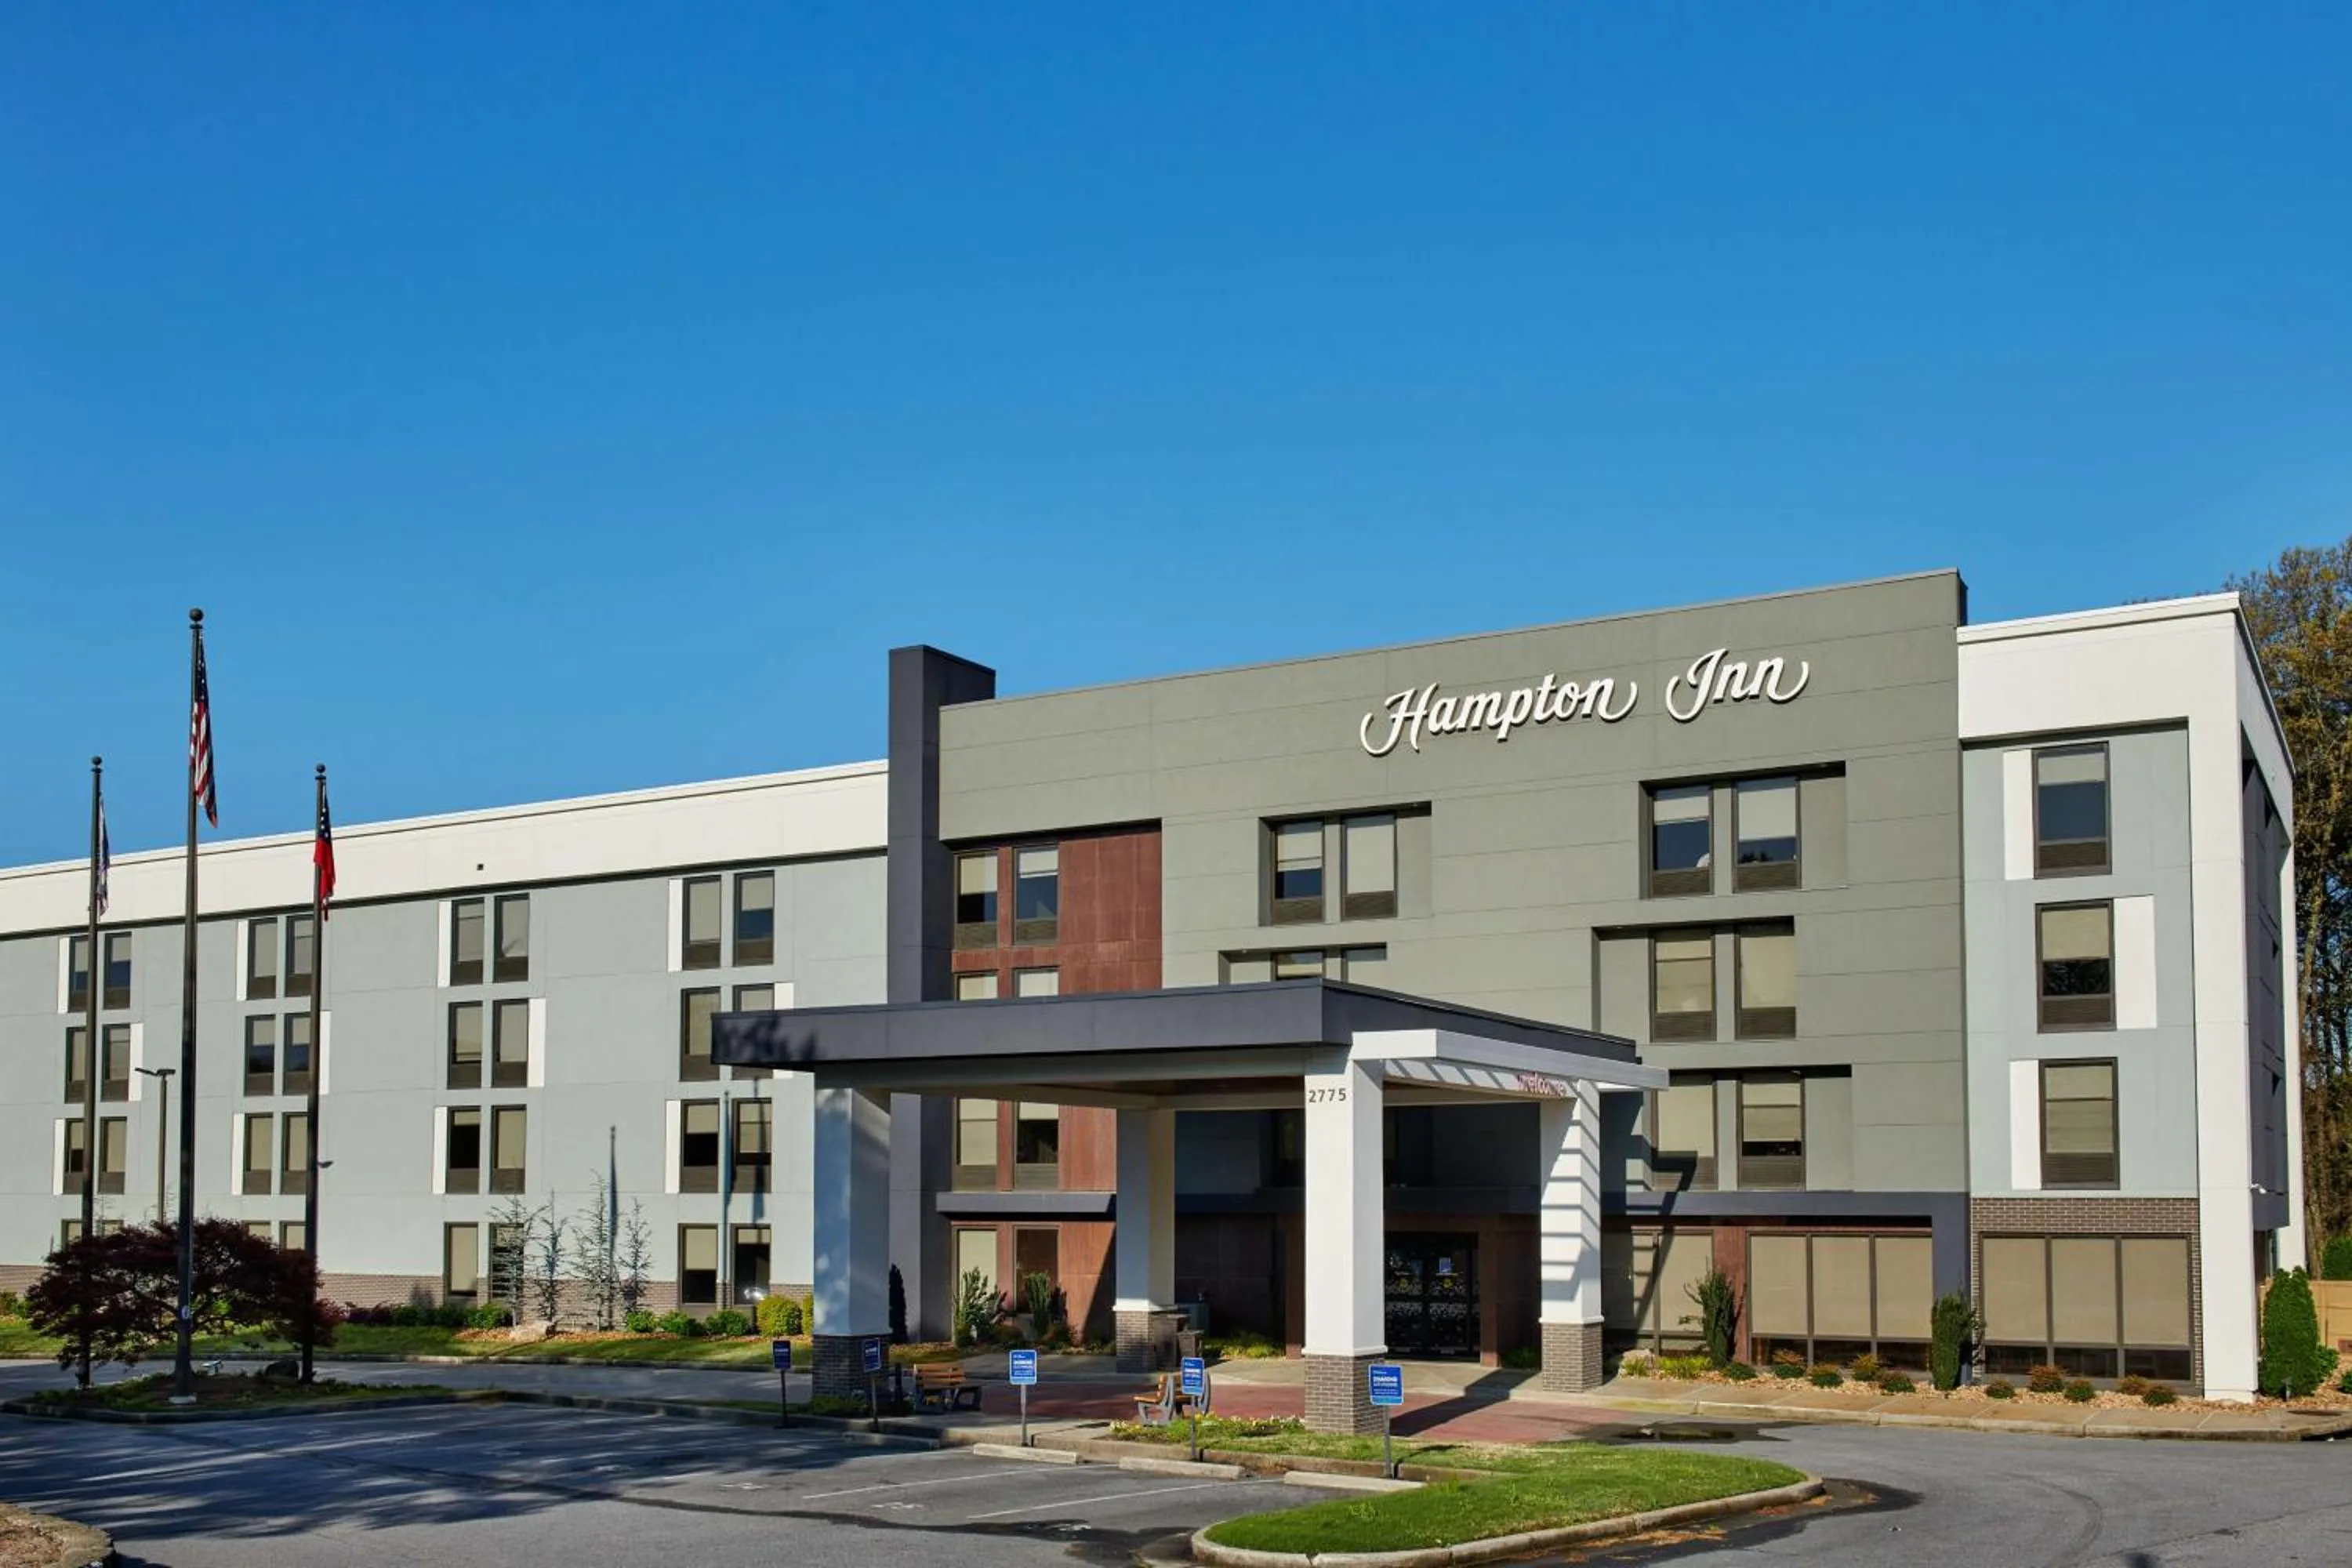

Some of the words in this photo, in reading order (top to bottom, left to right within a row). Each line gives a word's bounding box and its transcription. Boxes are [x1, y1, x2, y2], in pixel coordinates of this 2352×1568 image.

[1360, 673, 1637, 754] Hampton
[1665, 648, 1809, 721] Inn
[1308, 1087, 1346, 1103] 2775
